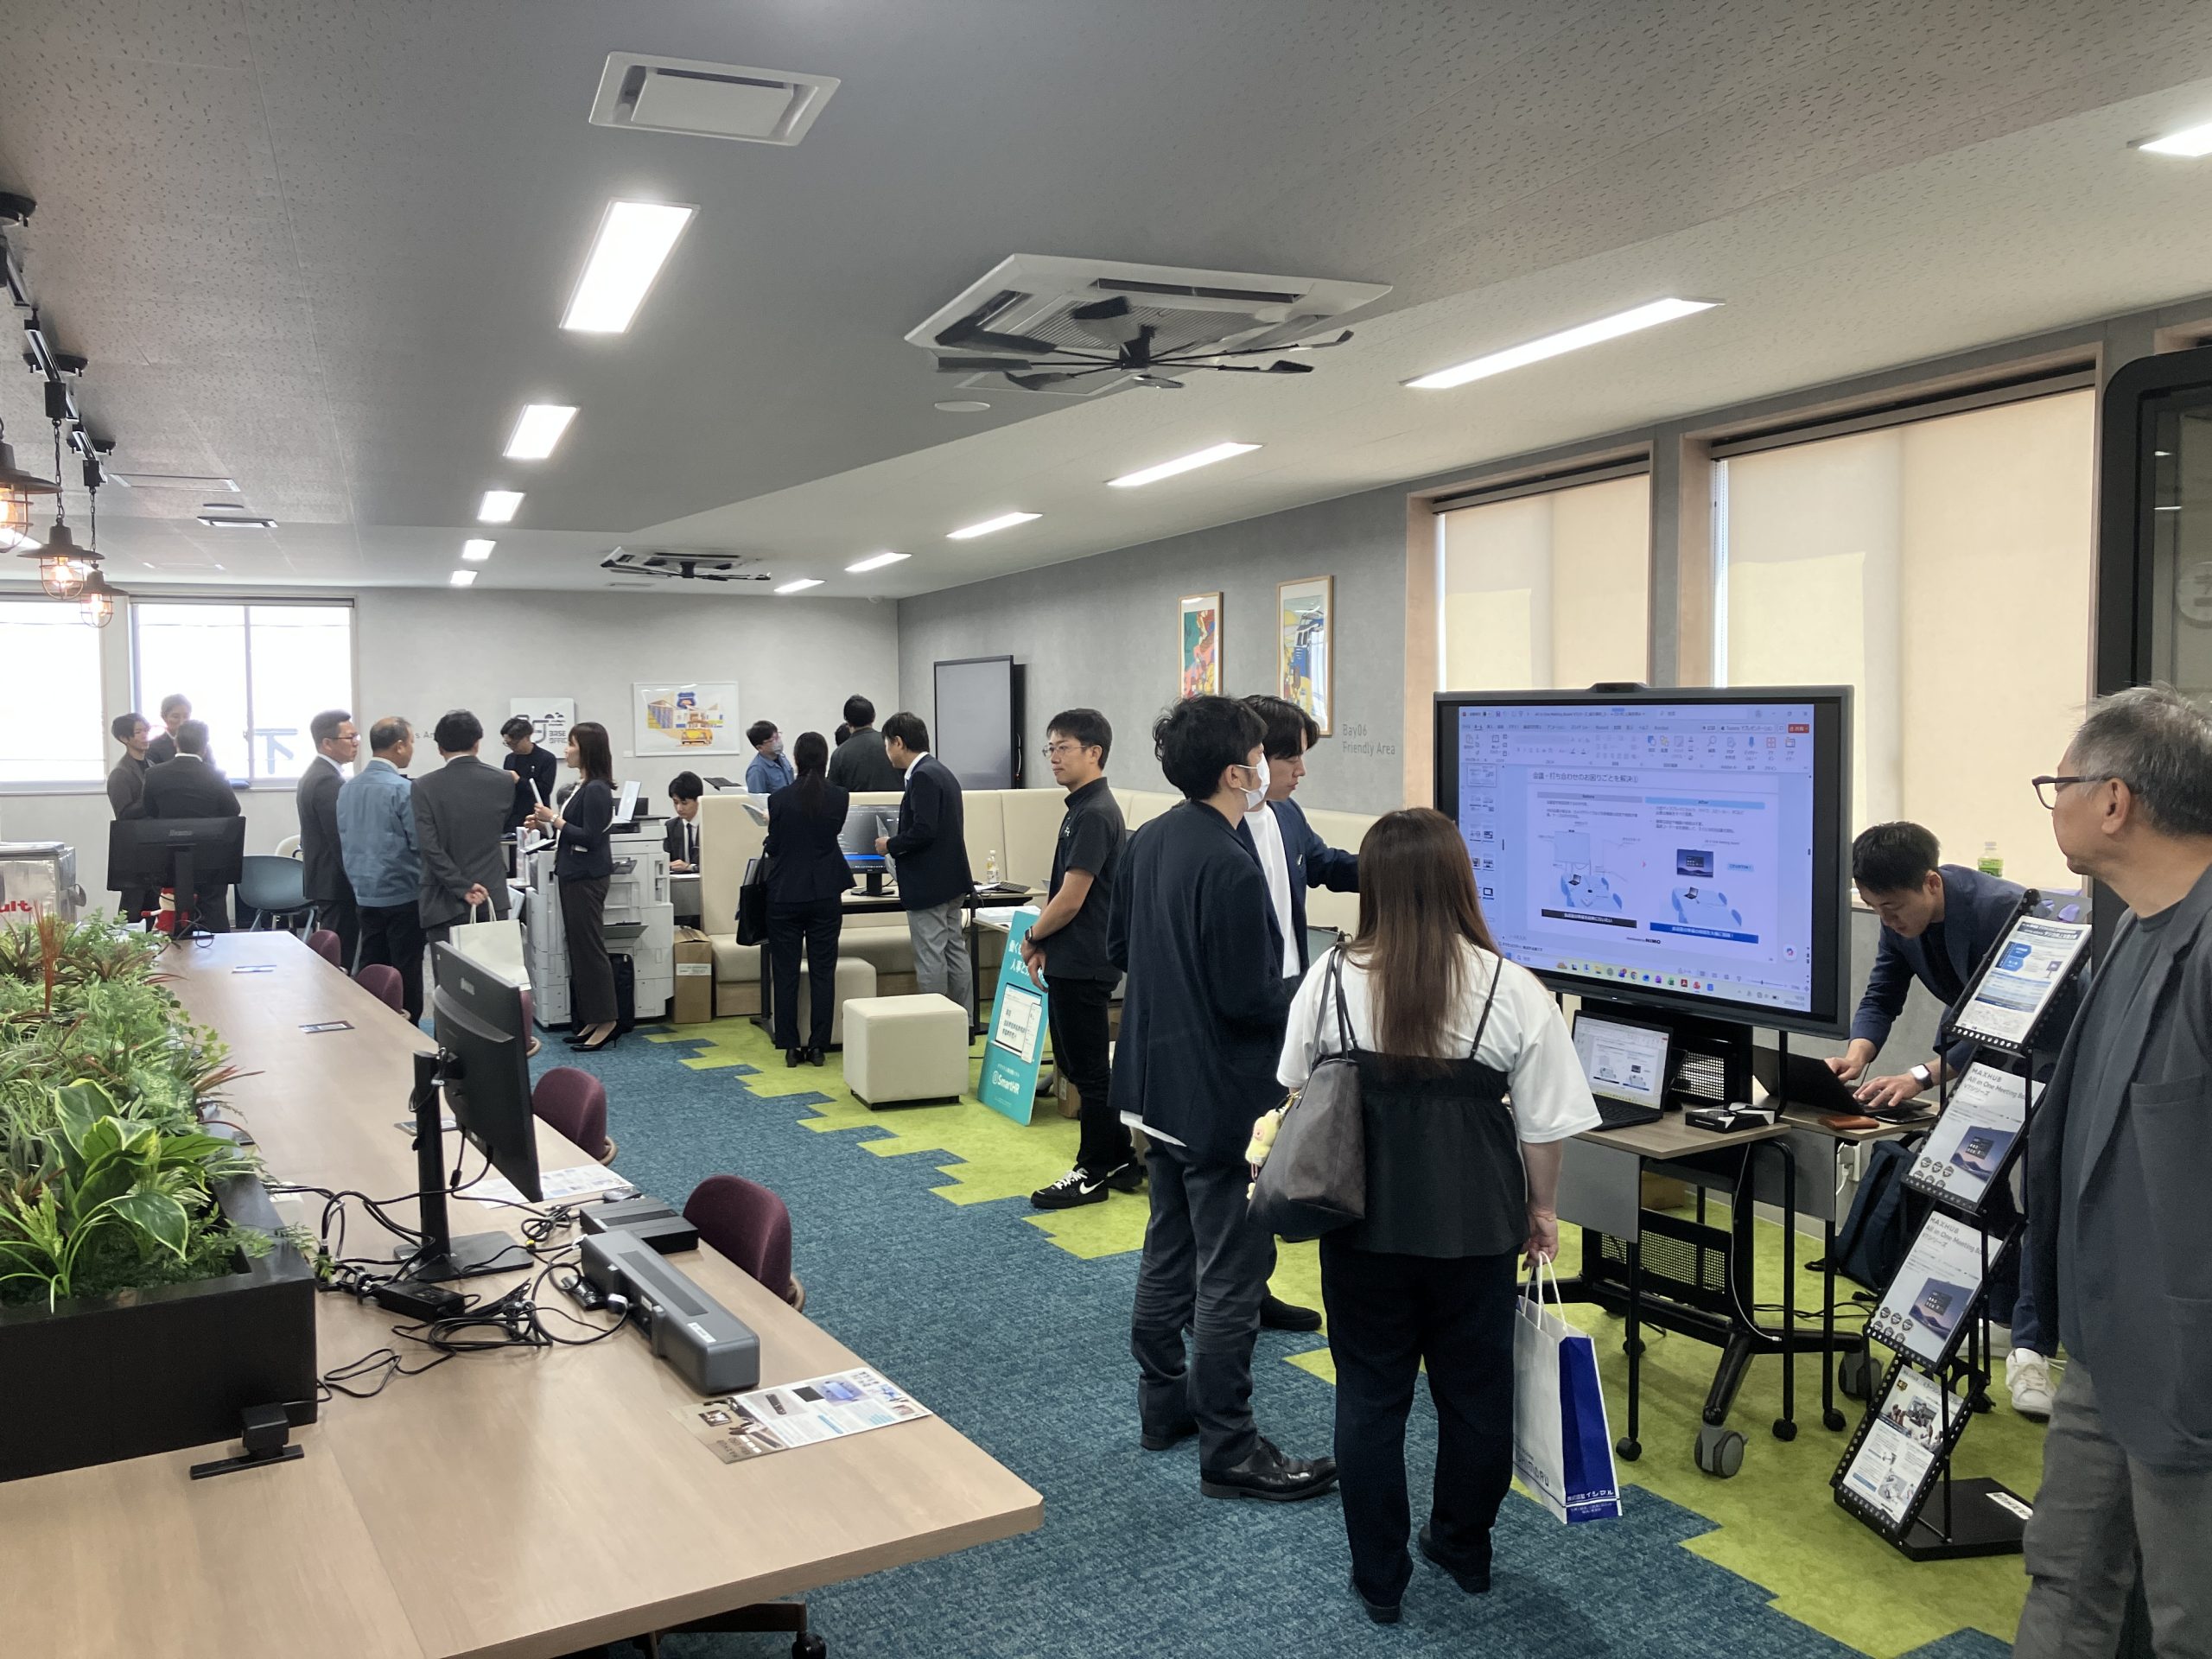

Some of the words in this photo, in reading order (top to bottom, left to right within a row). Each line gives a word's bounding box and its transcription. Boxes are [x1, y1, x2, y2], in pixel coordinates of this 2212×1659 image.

[1343, 723, 1368, 738] Bay06
[1343, 741, 1375, 757] Friendly
[1376, 741, 1395, 755] Area
[1971, 1068, 2003, 1083] MAXHUB
[1995, 1086, 2018, 1098] Meeting
[1929, 1217, 1961, 1233] MAXHUB
